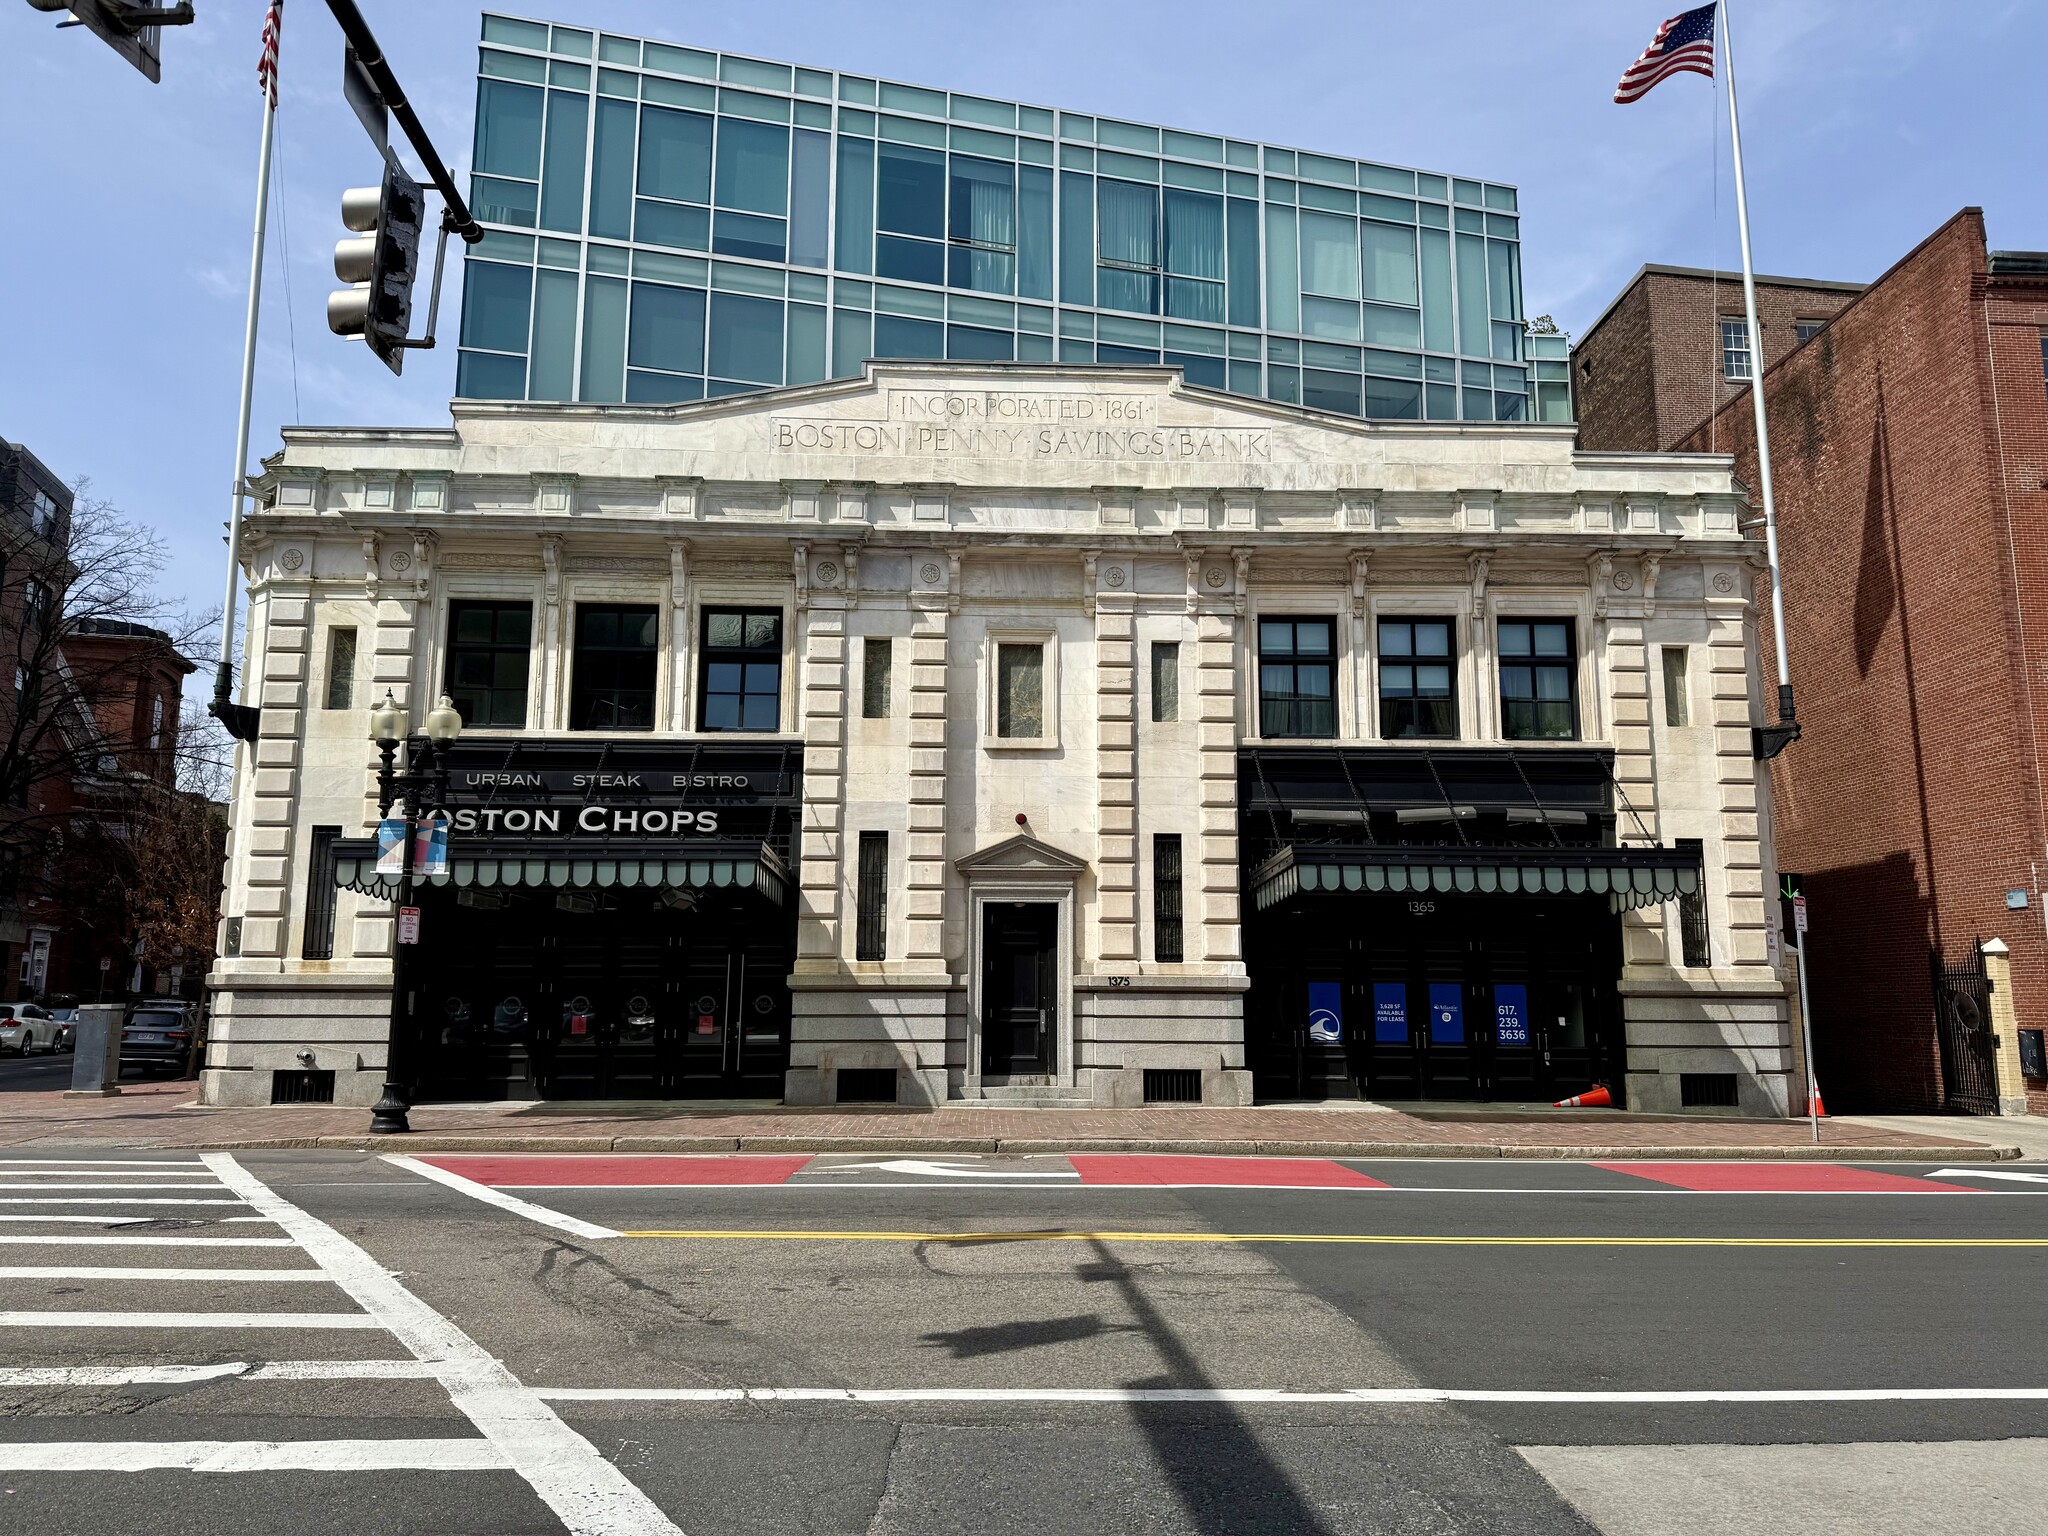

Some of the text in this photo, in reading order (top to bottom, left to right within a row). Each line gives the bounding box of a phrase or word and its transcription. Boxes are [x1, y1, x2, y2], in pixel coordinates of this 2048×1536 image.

[901, 397, 1143, 420] INCORPORATED 1861
[779, 424, 1266, 457] BOSTON PENNY SAVINGS BANK
[465, 773, 748, 788] URBAN STEAK BISTRO
[578, 806, 719, 832] CHOPS
[1408, 901, 1434, 912] 1365
[1108, 976, 1130, 986] 1375
[1498, 1005, 1517, 1015] 617.
[1499, 1018, 1521, 1028] 239.
[1500, 1030, 1525, 1040] 3636
